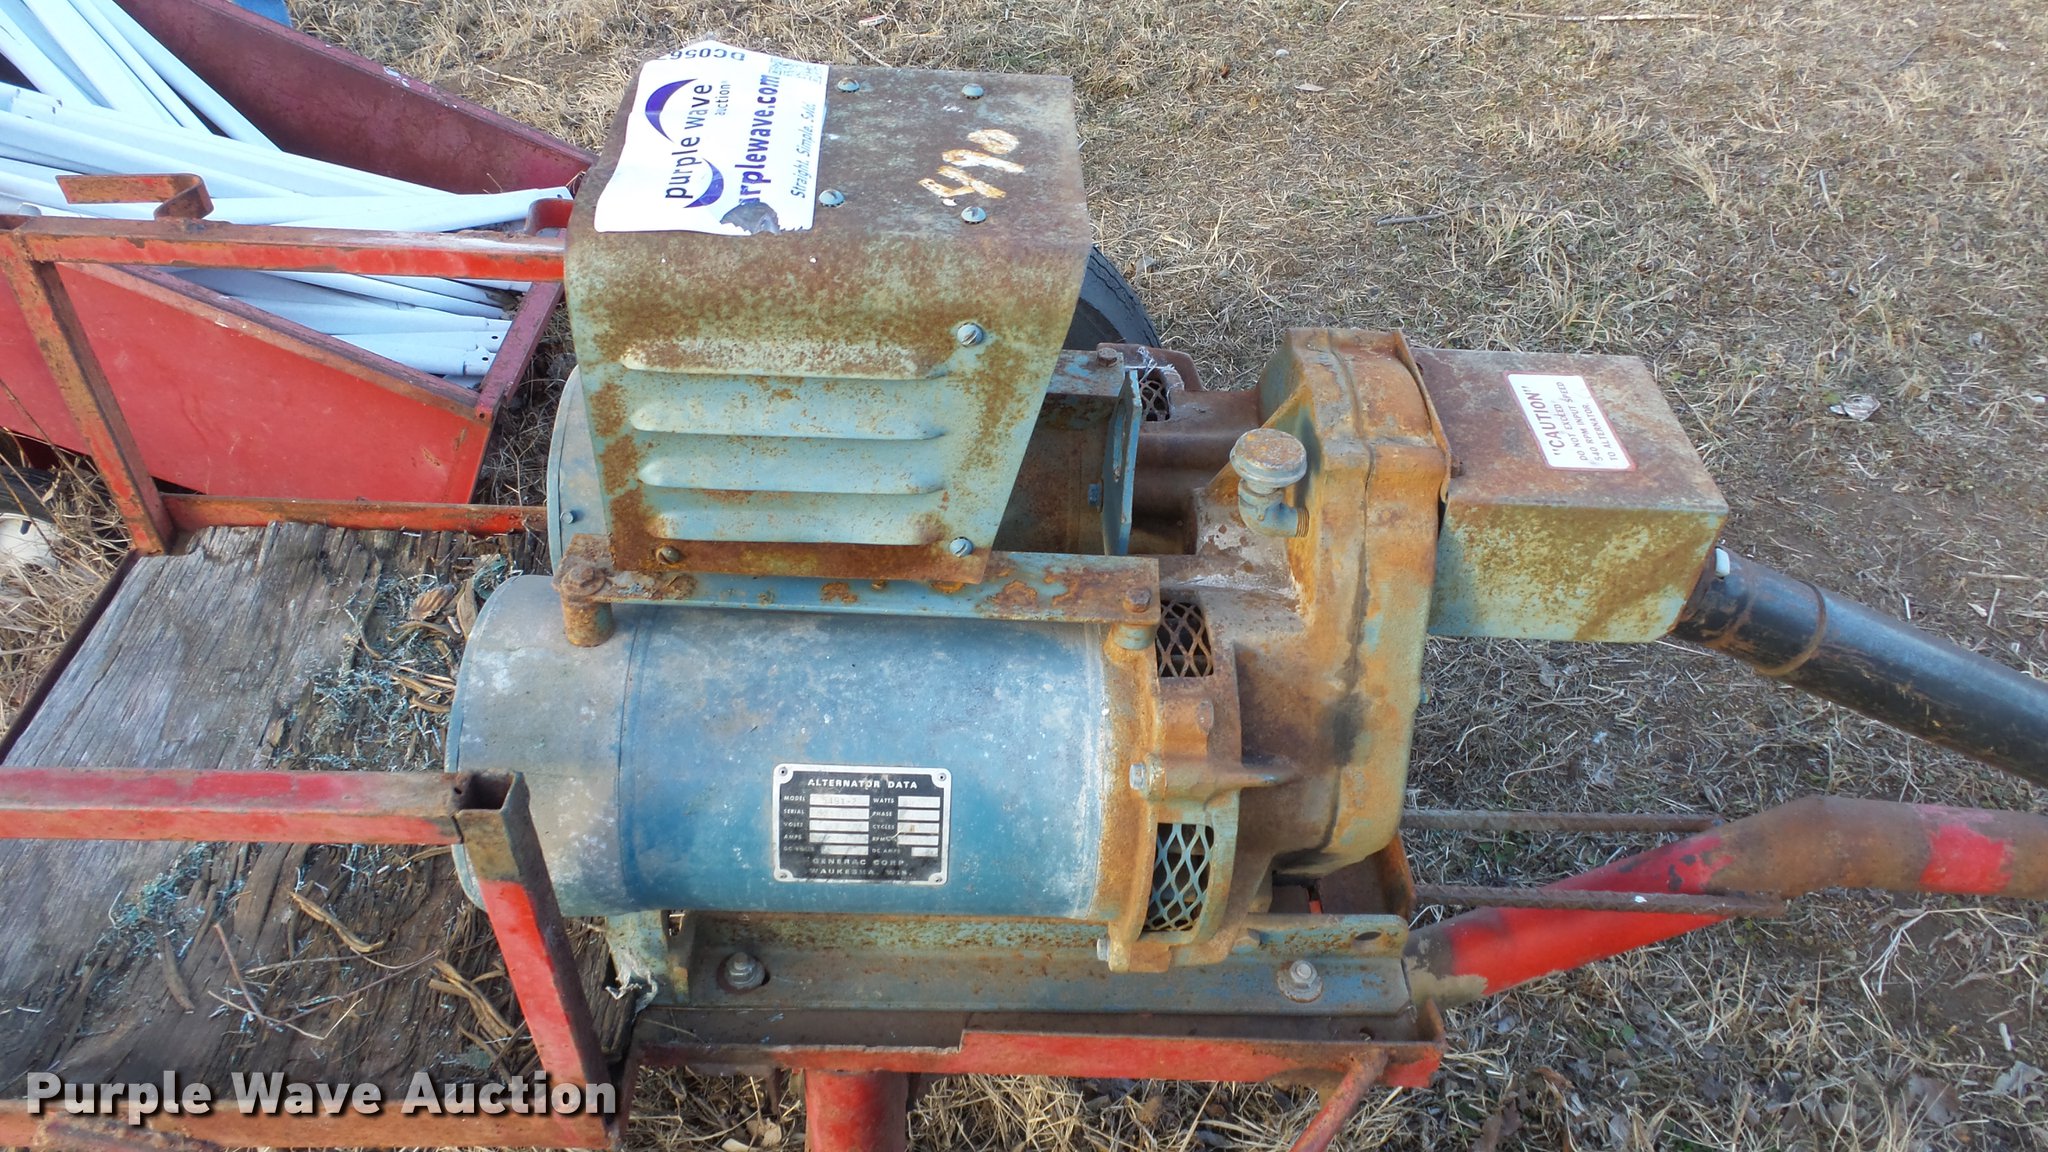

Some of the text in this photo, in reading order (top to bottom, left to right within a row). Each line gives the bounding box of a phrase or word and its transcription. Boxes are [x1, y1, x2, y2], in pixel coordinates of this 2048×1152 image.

[660, 47, 746, 62] DC056
[664, 83, 713, 199] purple wave
[734, 74, 782, 204] rplewave.com
[1556, 381, 1574, 404] SPEED
[1567, 405, 1585, 426] INPUT
[1553, 403, 1589, 461] DO NOT EXCEED
[1580, 428, 1595, 445] RPM
[1607, 451, 1619, 461] TO
[807, 778, 918, 790] ALTERNATOR DATA
[812, 857, 867, 866] GENERAC
